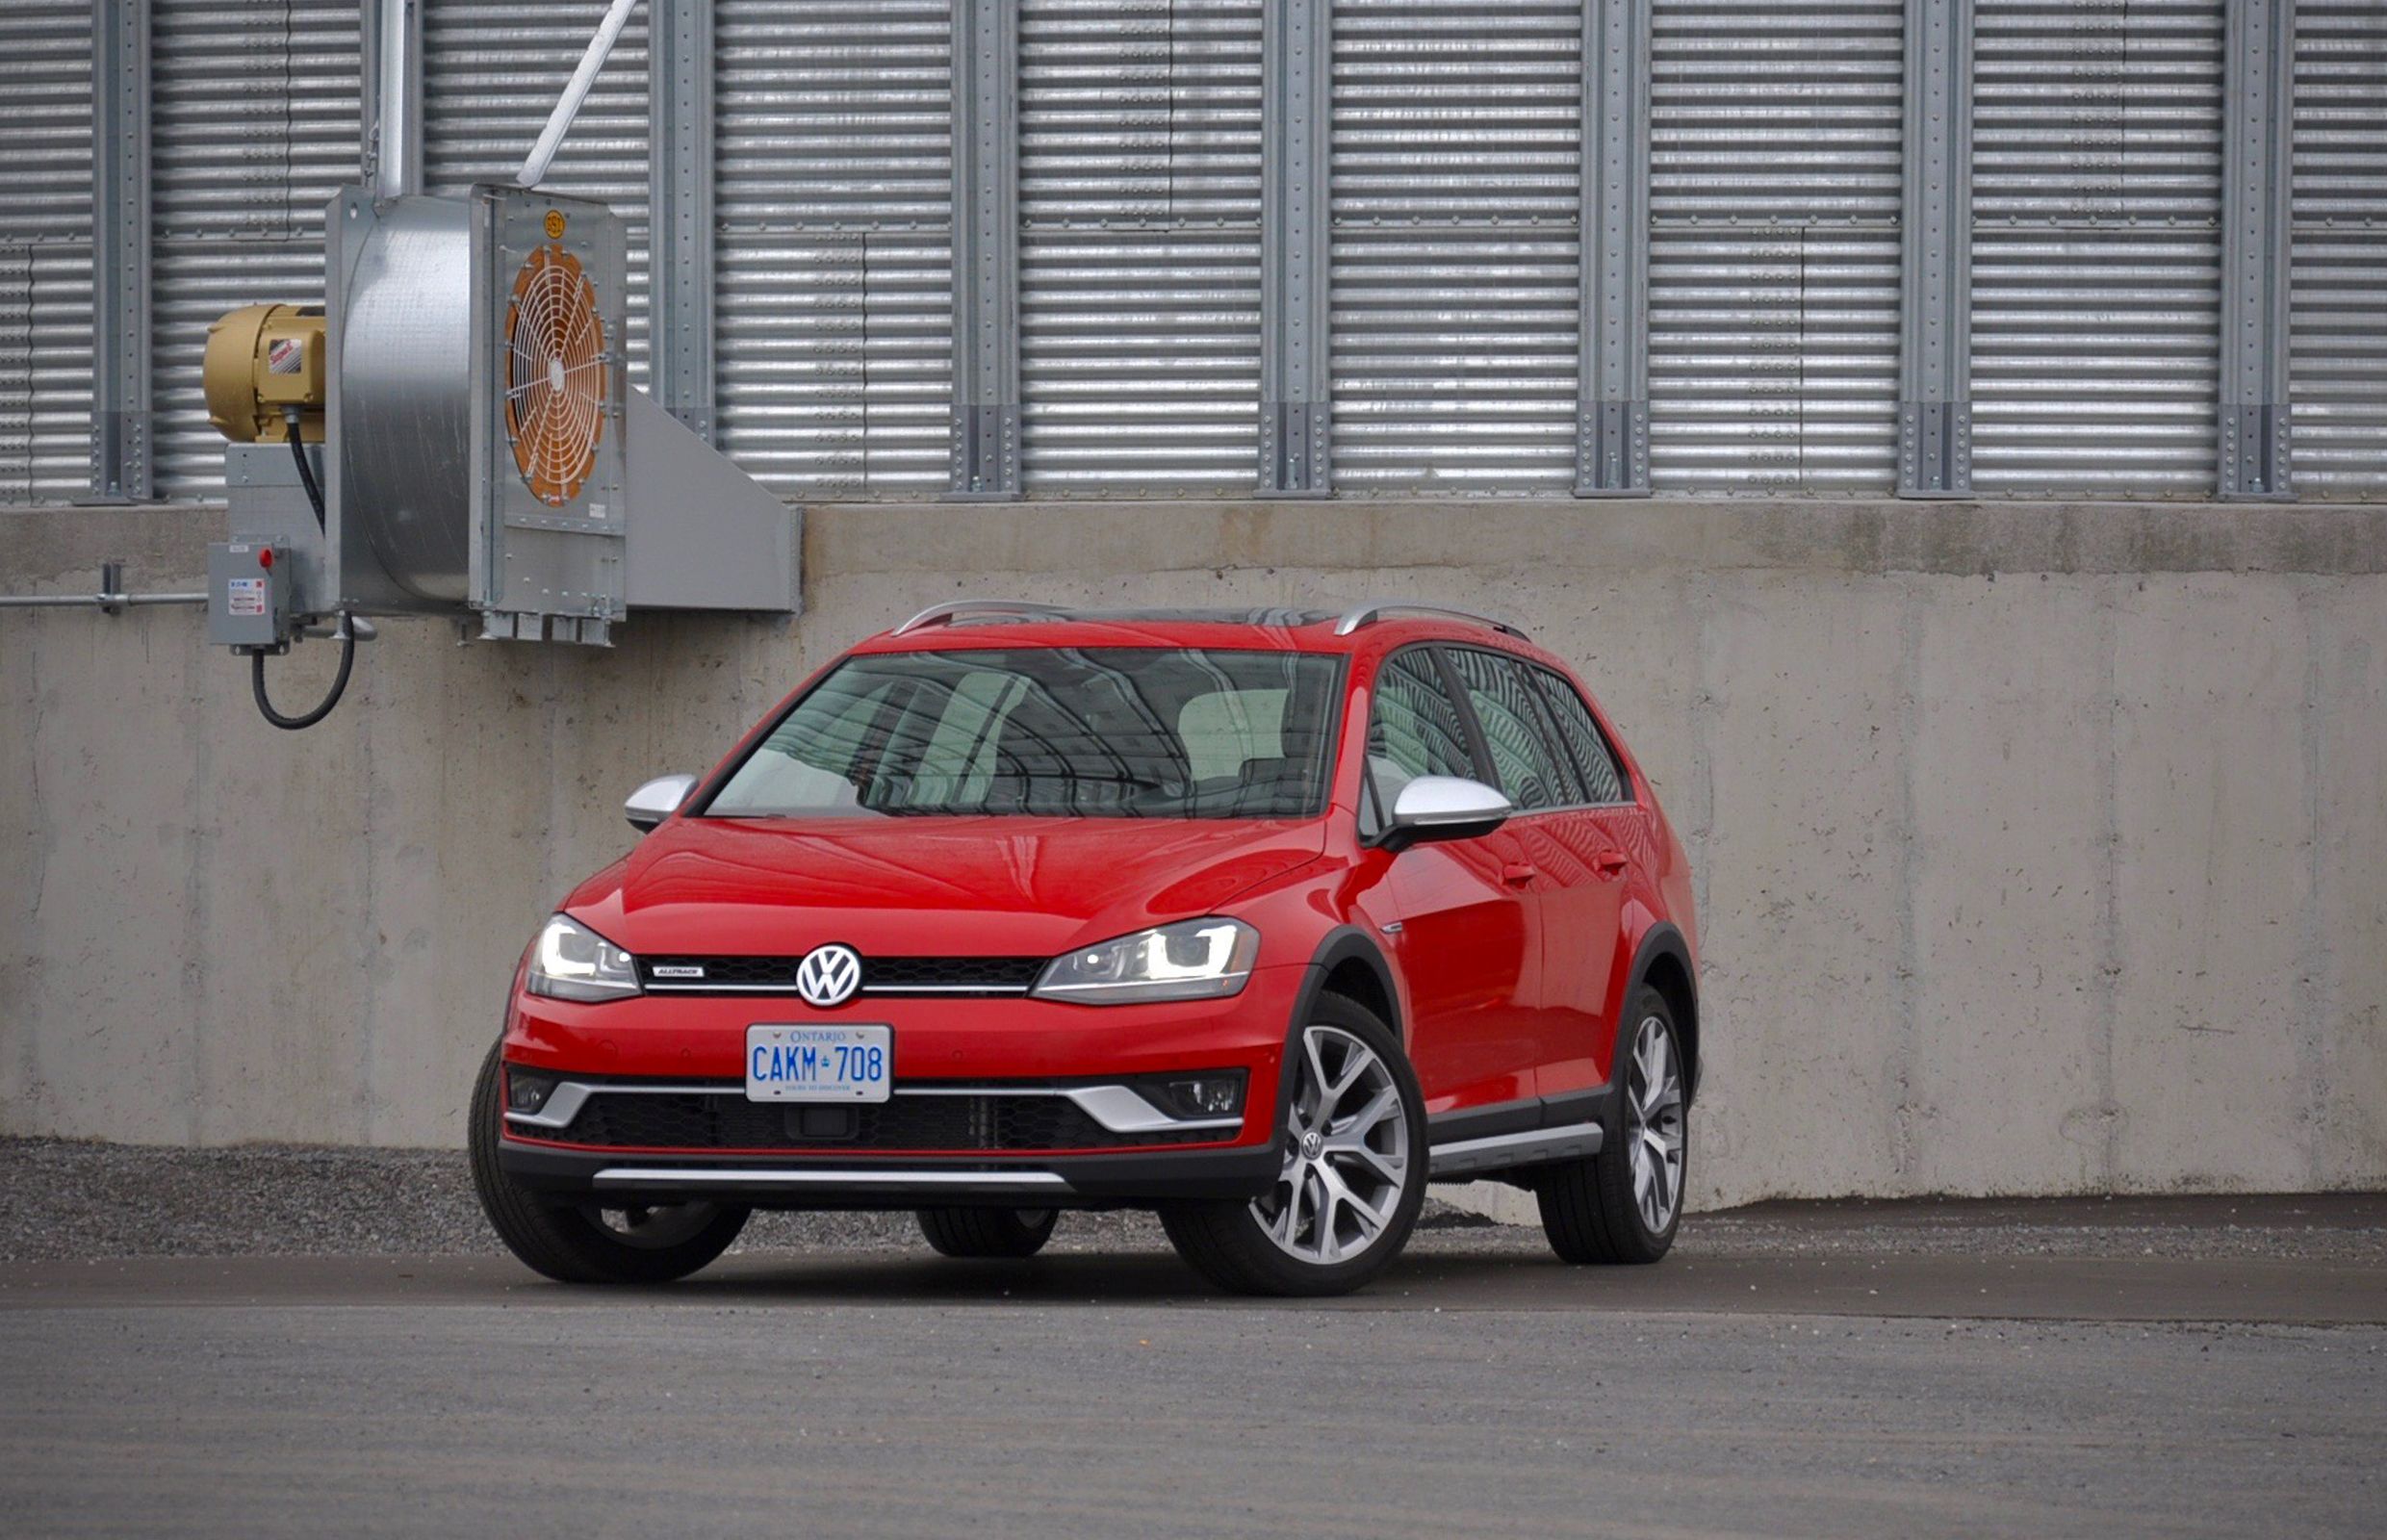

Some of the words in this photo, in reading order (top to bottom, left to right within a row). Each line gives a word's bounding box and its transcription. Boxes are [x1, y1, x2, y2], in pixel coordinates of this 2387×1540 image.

[790, 1031, 846, 1042] ONTARIO
[753, 1046, 816, 1082] CAKM
[834, 1046, 882, 1082] 708
